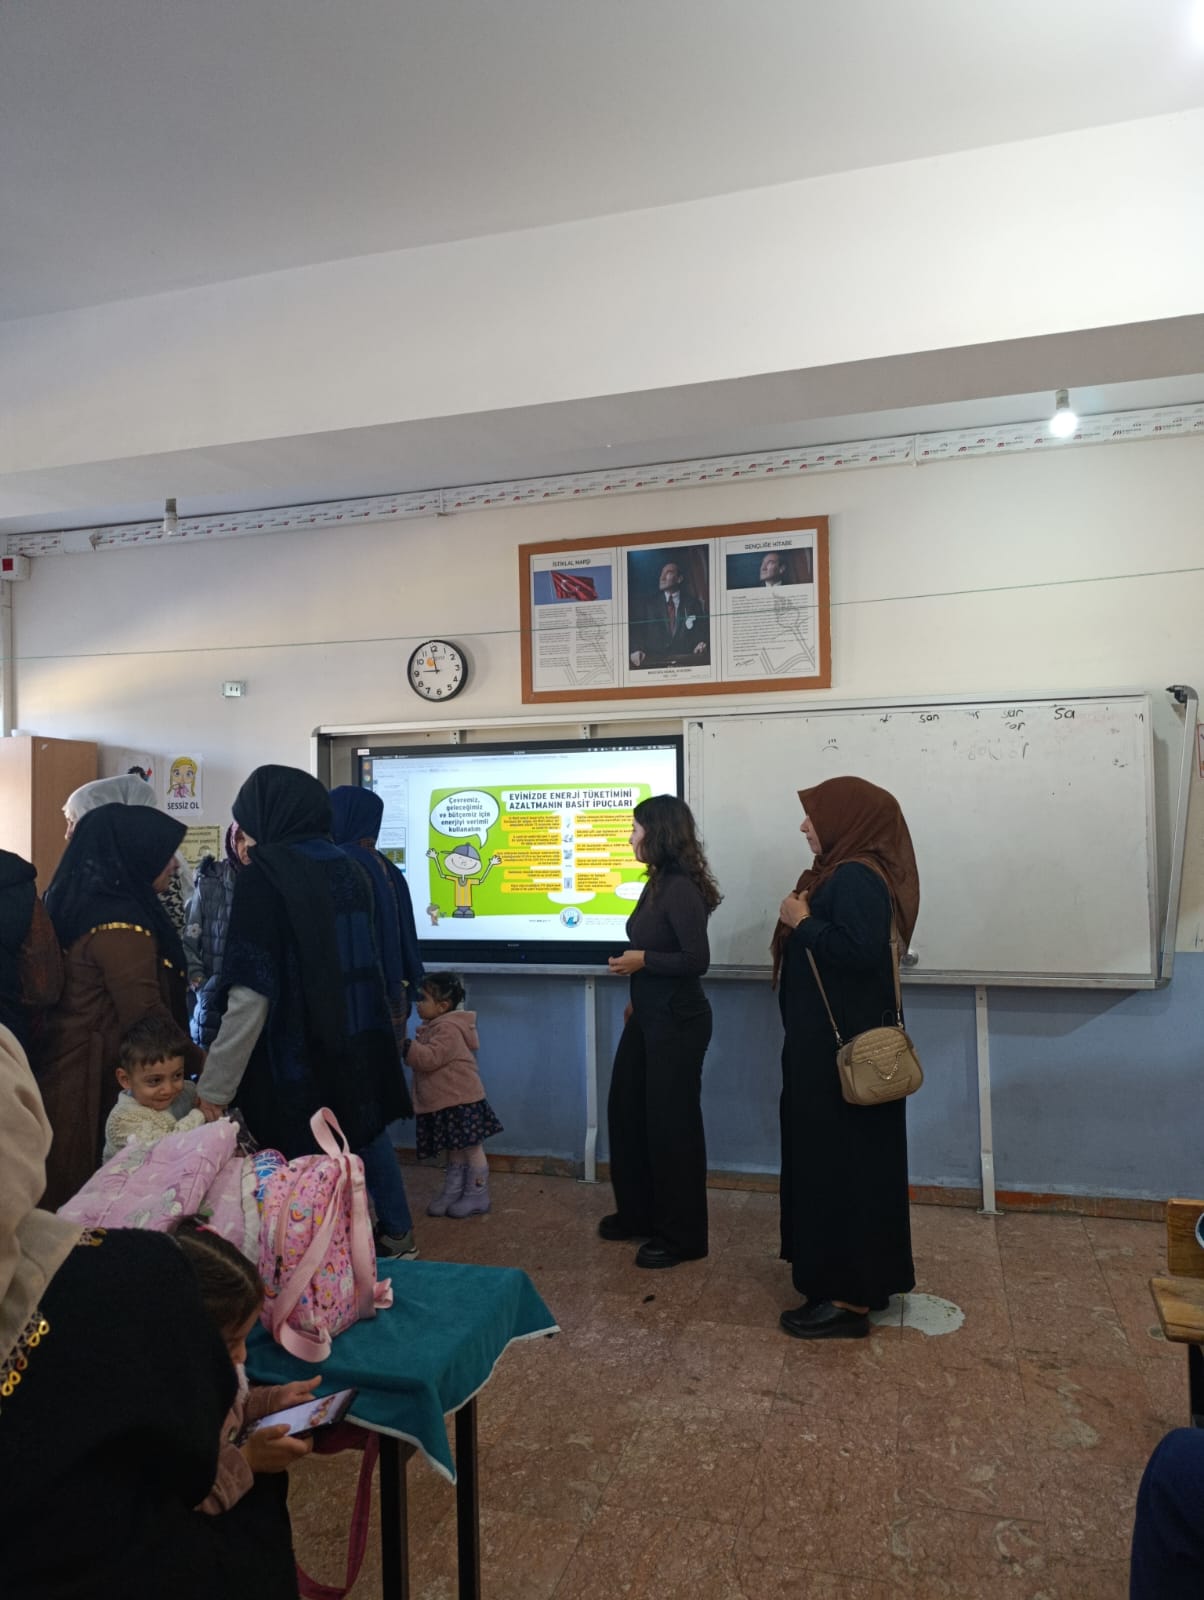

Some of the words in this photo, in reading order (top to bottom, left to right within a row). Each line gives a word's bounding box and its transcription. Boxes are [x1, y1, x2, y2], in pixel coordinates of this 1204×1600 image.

[509, 791, 547, 801] EVİNİZDE
[550, 790, 579, 800] ENERJİ
[583, 788, 632, 799] TÜKETİMİNİ
[167, 801, 189, 810] SESSİZ
[190, 801, 200, 809] OL
[509, 801, 562, 810] AZALTMANIN
[565, 799, 590, 808] BASİT
[593, 798, 633, 808] İPUÇLARI
